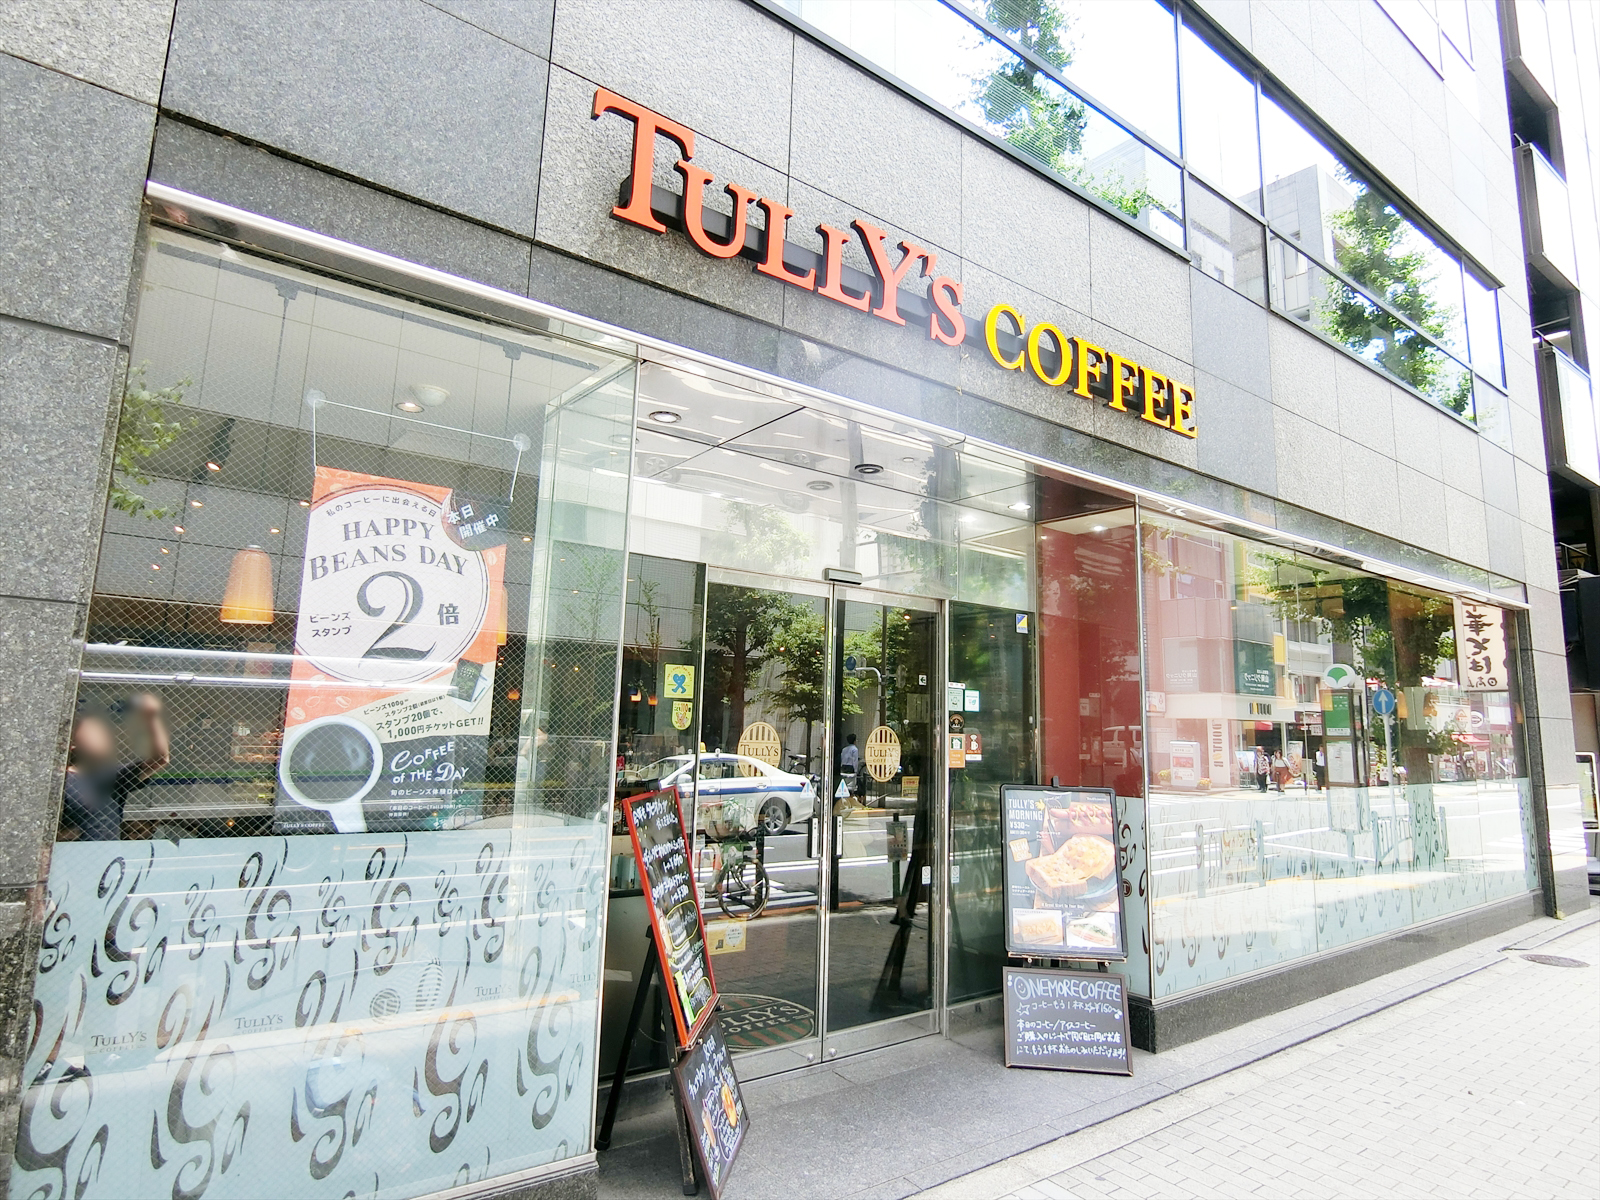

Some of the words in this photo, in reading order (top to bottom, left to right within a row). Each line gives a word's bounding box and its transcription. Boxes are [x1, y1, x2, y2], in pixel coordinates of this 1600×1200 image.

[592, 86, 967, 347] TULLY'S
[984, 303, 1198, 439] COFFEE
[326, 495, 437, 517] 私のコーヒーに出会える日
[447, 504, 474, 525] 本日
[342, 517, 434, 542] HAPPY
[459, 513, 500, 540] 開催中
[309, 543, 407, 582] BEANS
[419, 545, 469, 576] DAY
[309, 611, 351, 624] ビーンズ
[356, 570, 437, 669] 2
[437, 603, 460, 625] 倍
[311, 625, 352, 638] スタンプ
[740, 744, 779, 756] TULLY'S
[392, 772, 406, 784] of
[410, 767, 433, 783] THE
[434, 762, 470, 782] DAY
[1008, 798, 1035, 810] TULLY'S
[1008, 809, 1043, 821] MORNING
[233, 1014, 284, 1029] TULLY'S
[720, 1005, 800, 1027] LLY'S
[723, 1017, 791, 1035] OFFEE
[90, 1031, 147, 1047] TULLY'S
